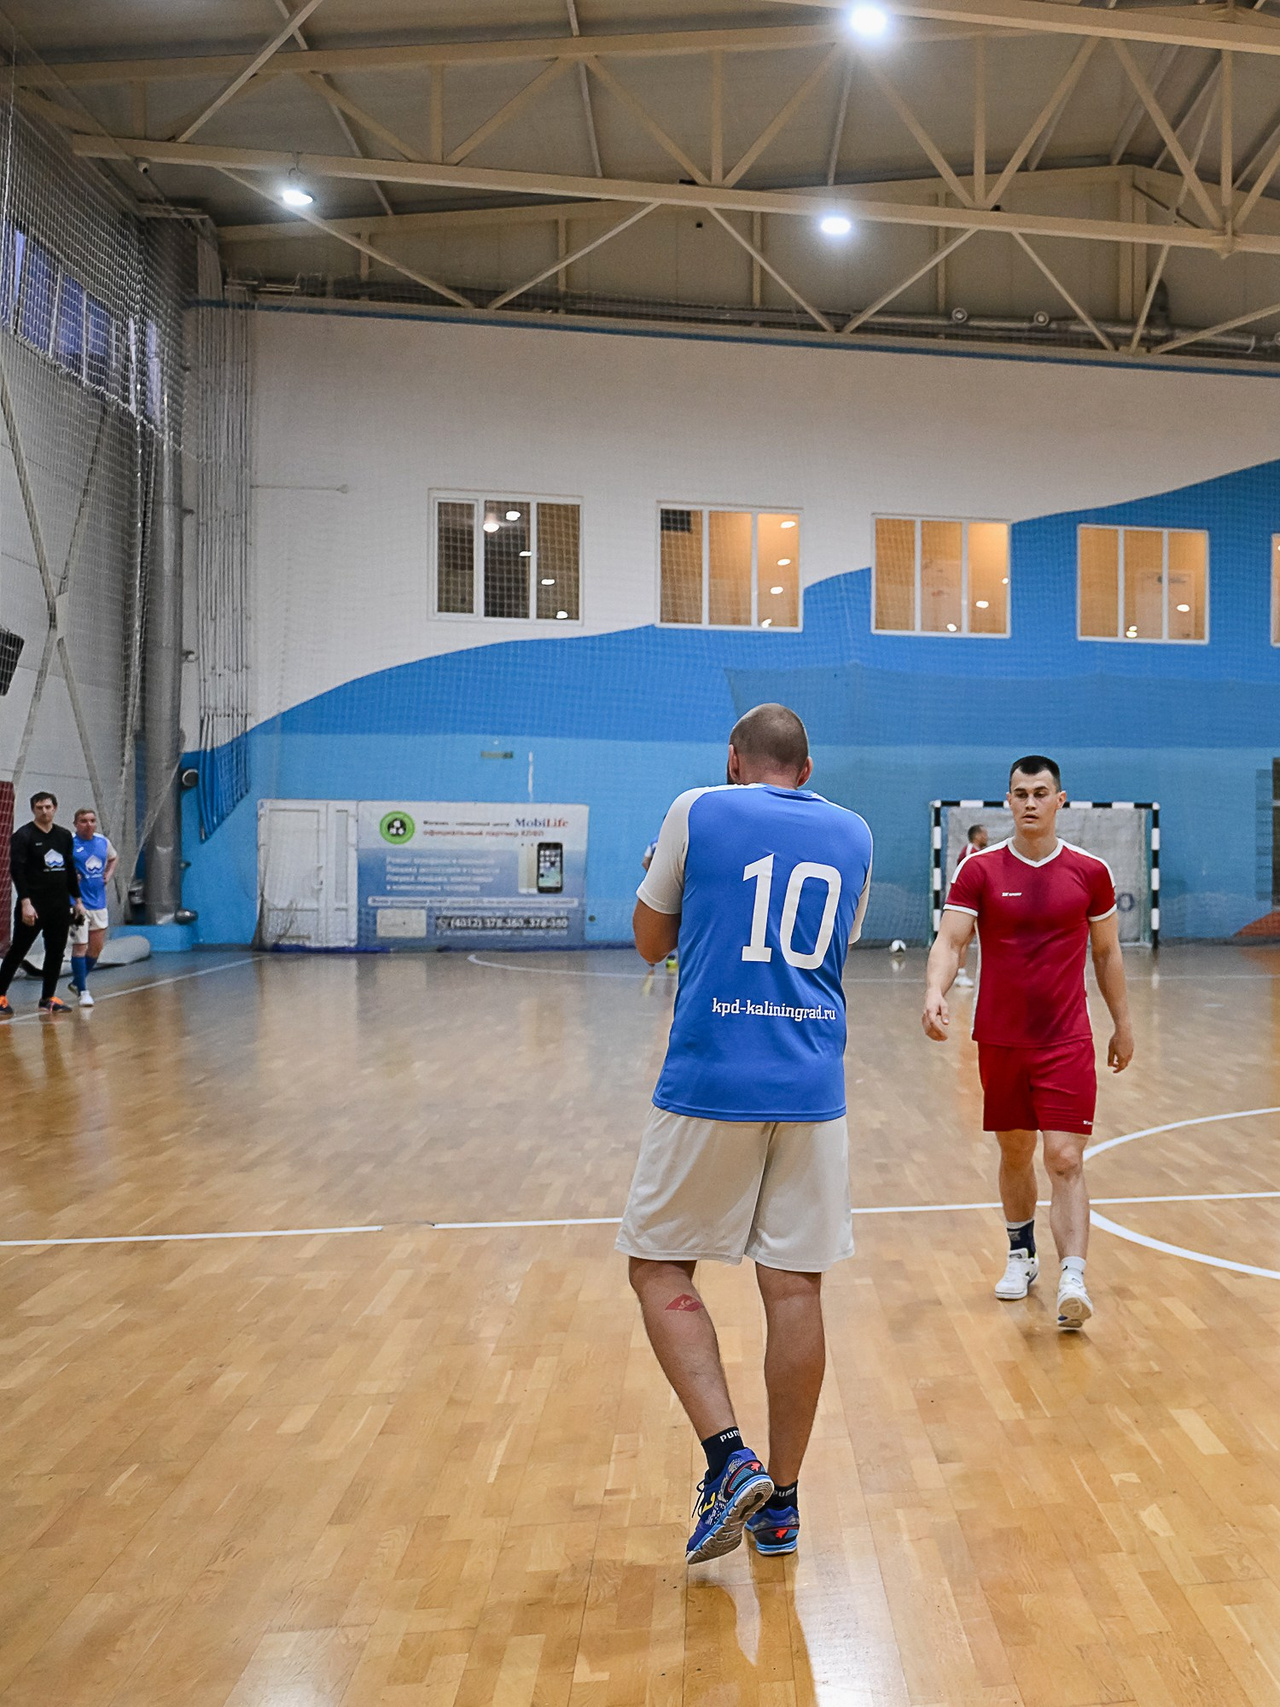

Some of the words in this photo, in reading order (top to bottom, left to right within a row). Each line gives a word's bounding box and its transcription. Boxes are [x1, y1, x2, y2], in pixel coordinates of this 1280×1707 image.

[515, 818, 569, 828] MobiLife
[741, 853, 842, 970] 10
[712, 997, 836, 1021] kpd-kaliningrad.ru
